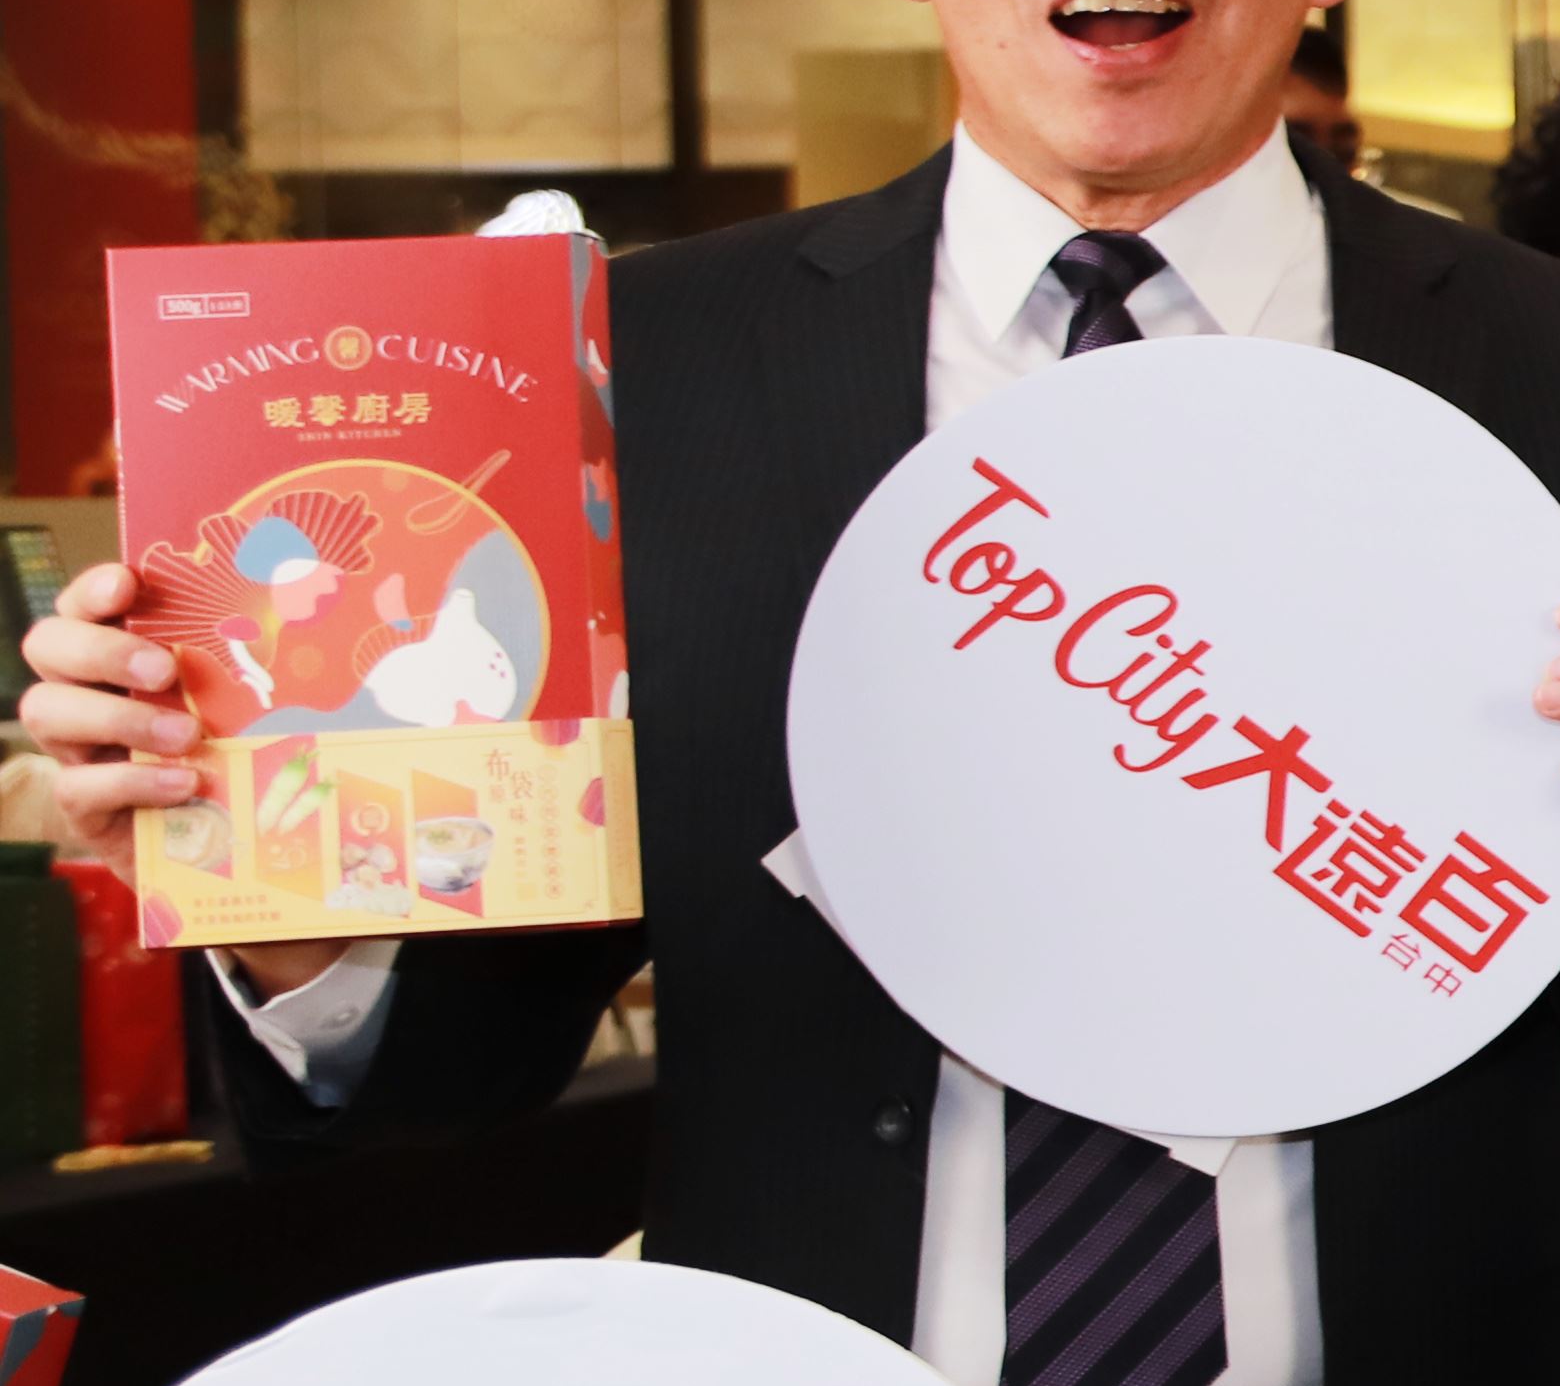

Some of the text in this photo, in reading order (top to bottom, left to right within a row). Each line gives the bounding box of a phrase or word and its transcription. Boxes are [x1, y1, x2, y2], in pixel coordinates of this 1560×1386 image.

[155, 333, 539, 414] WARMING CUISINE
[921, 456, 1220, 774] Top City
[1180, 714, 1550, 973] 大遠百
[1380, 932, 1464, 1000] 台中
